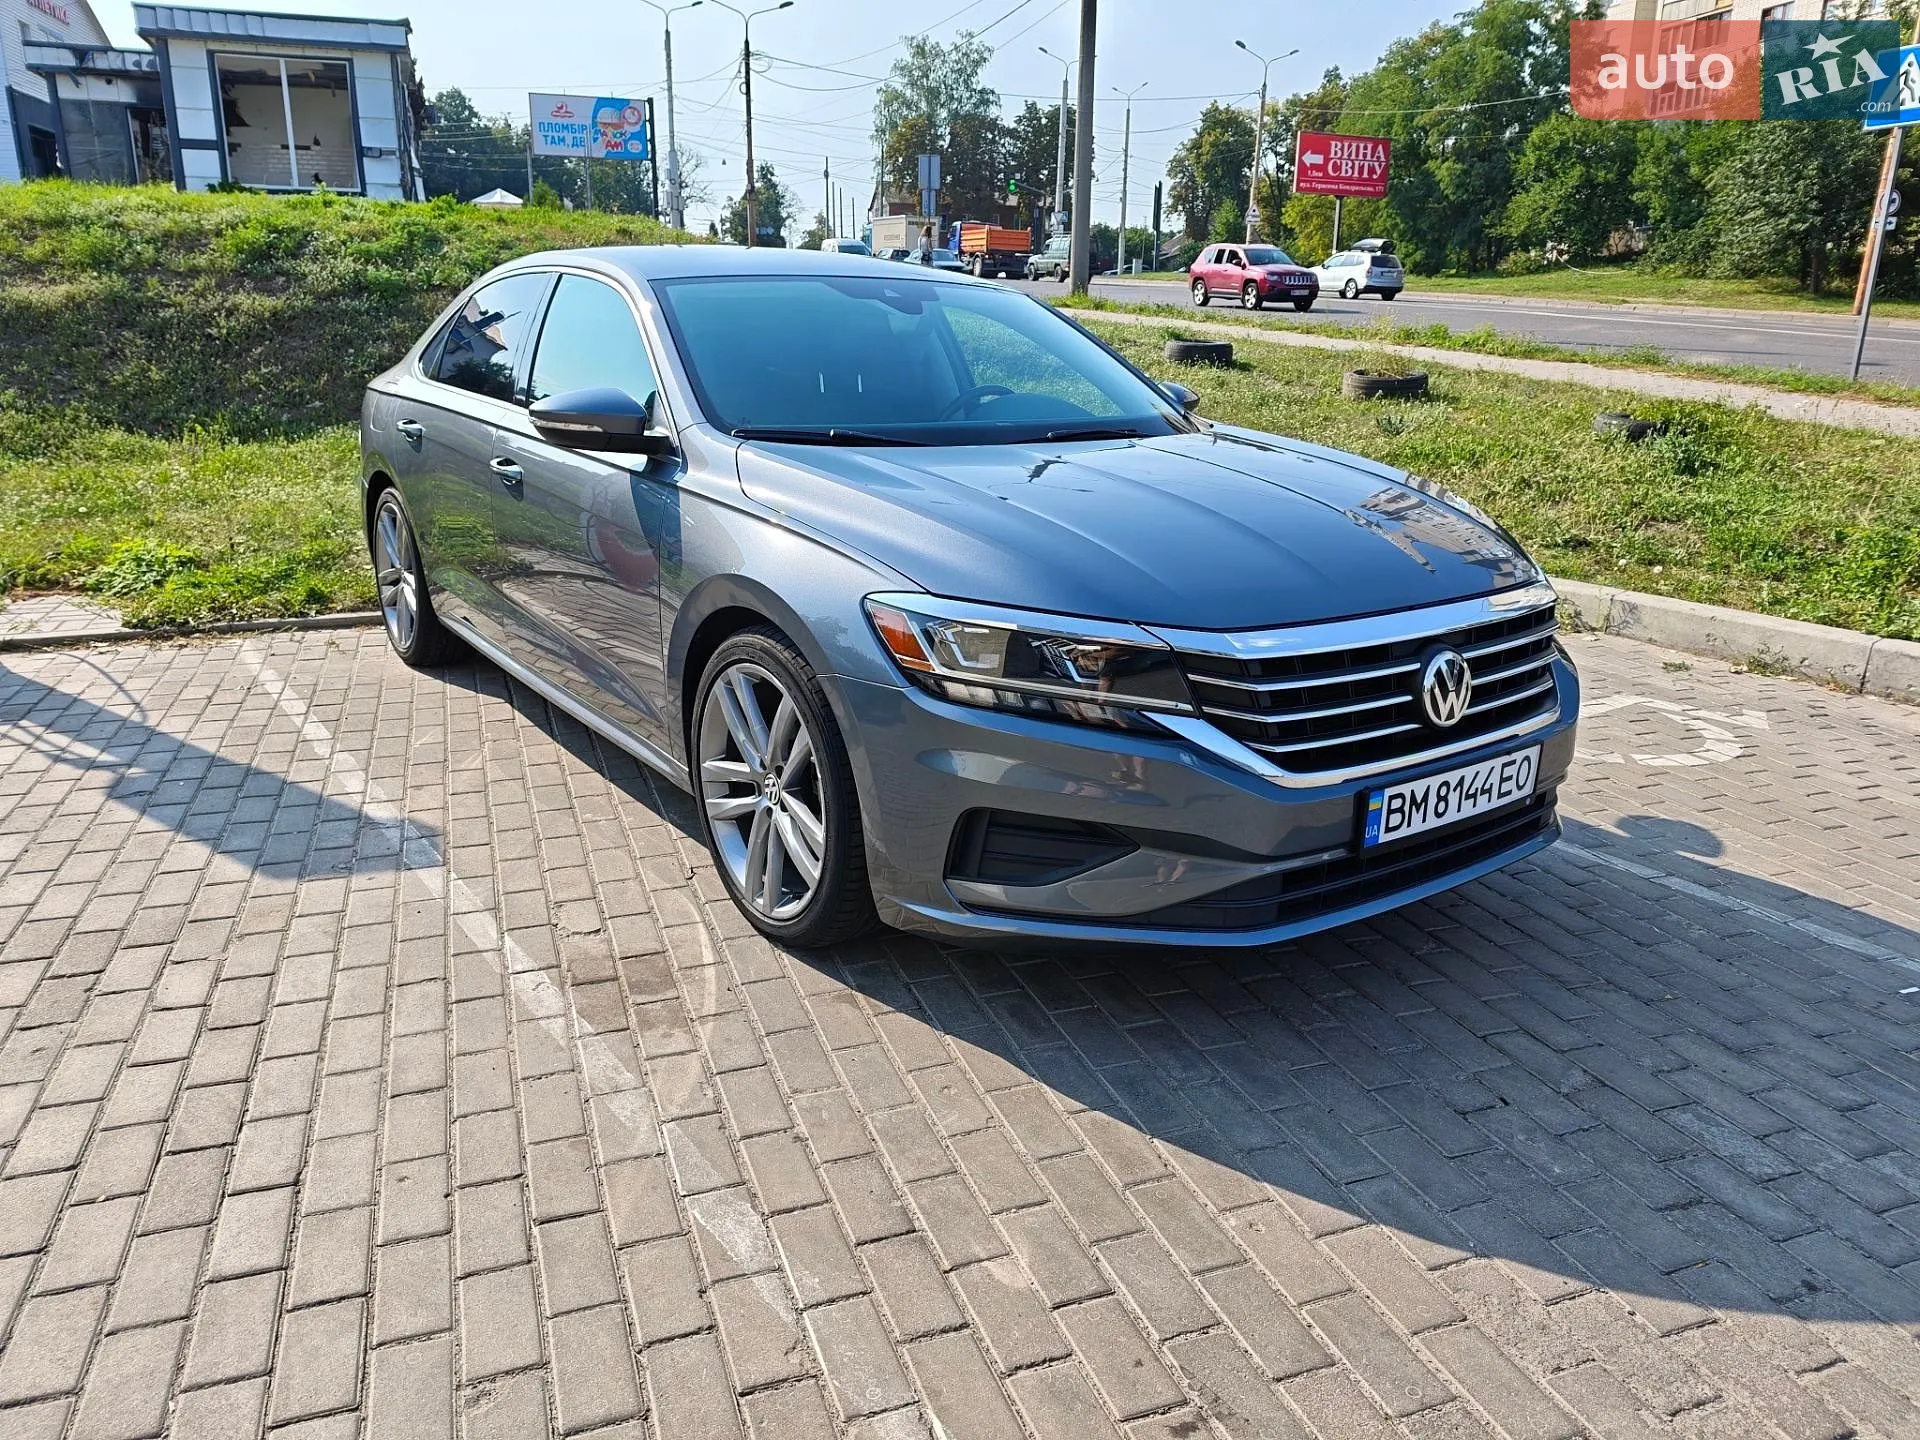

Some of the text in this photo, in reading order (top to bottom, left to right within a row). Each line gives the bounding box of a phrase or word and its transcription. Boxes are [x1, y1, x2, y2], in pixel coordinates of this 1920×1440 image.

[538, 121, 588, 133] ПЛОМБІР
[543, 134, 570, 148] ТАМ,
[1329, 140, 1387, 161] ВИНА
[1327, 159, 1387, 179] СВІТУ
[1365, 824, 1378, 838] UA
